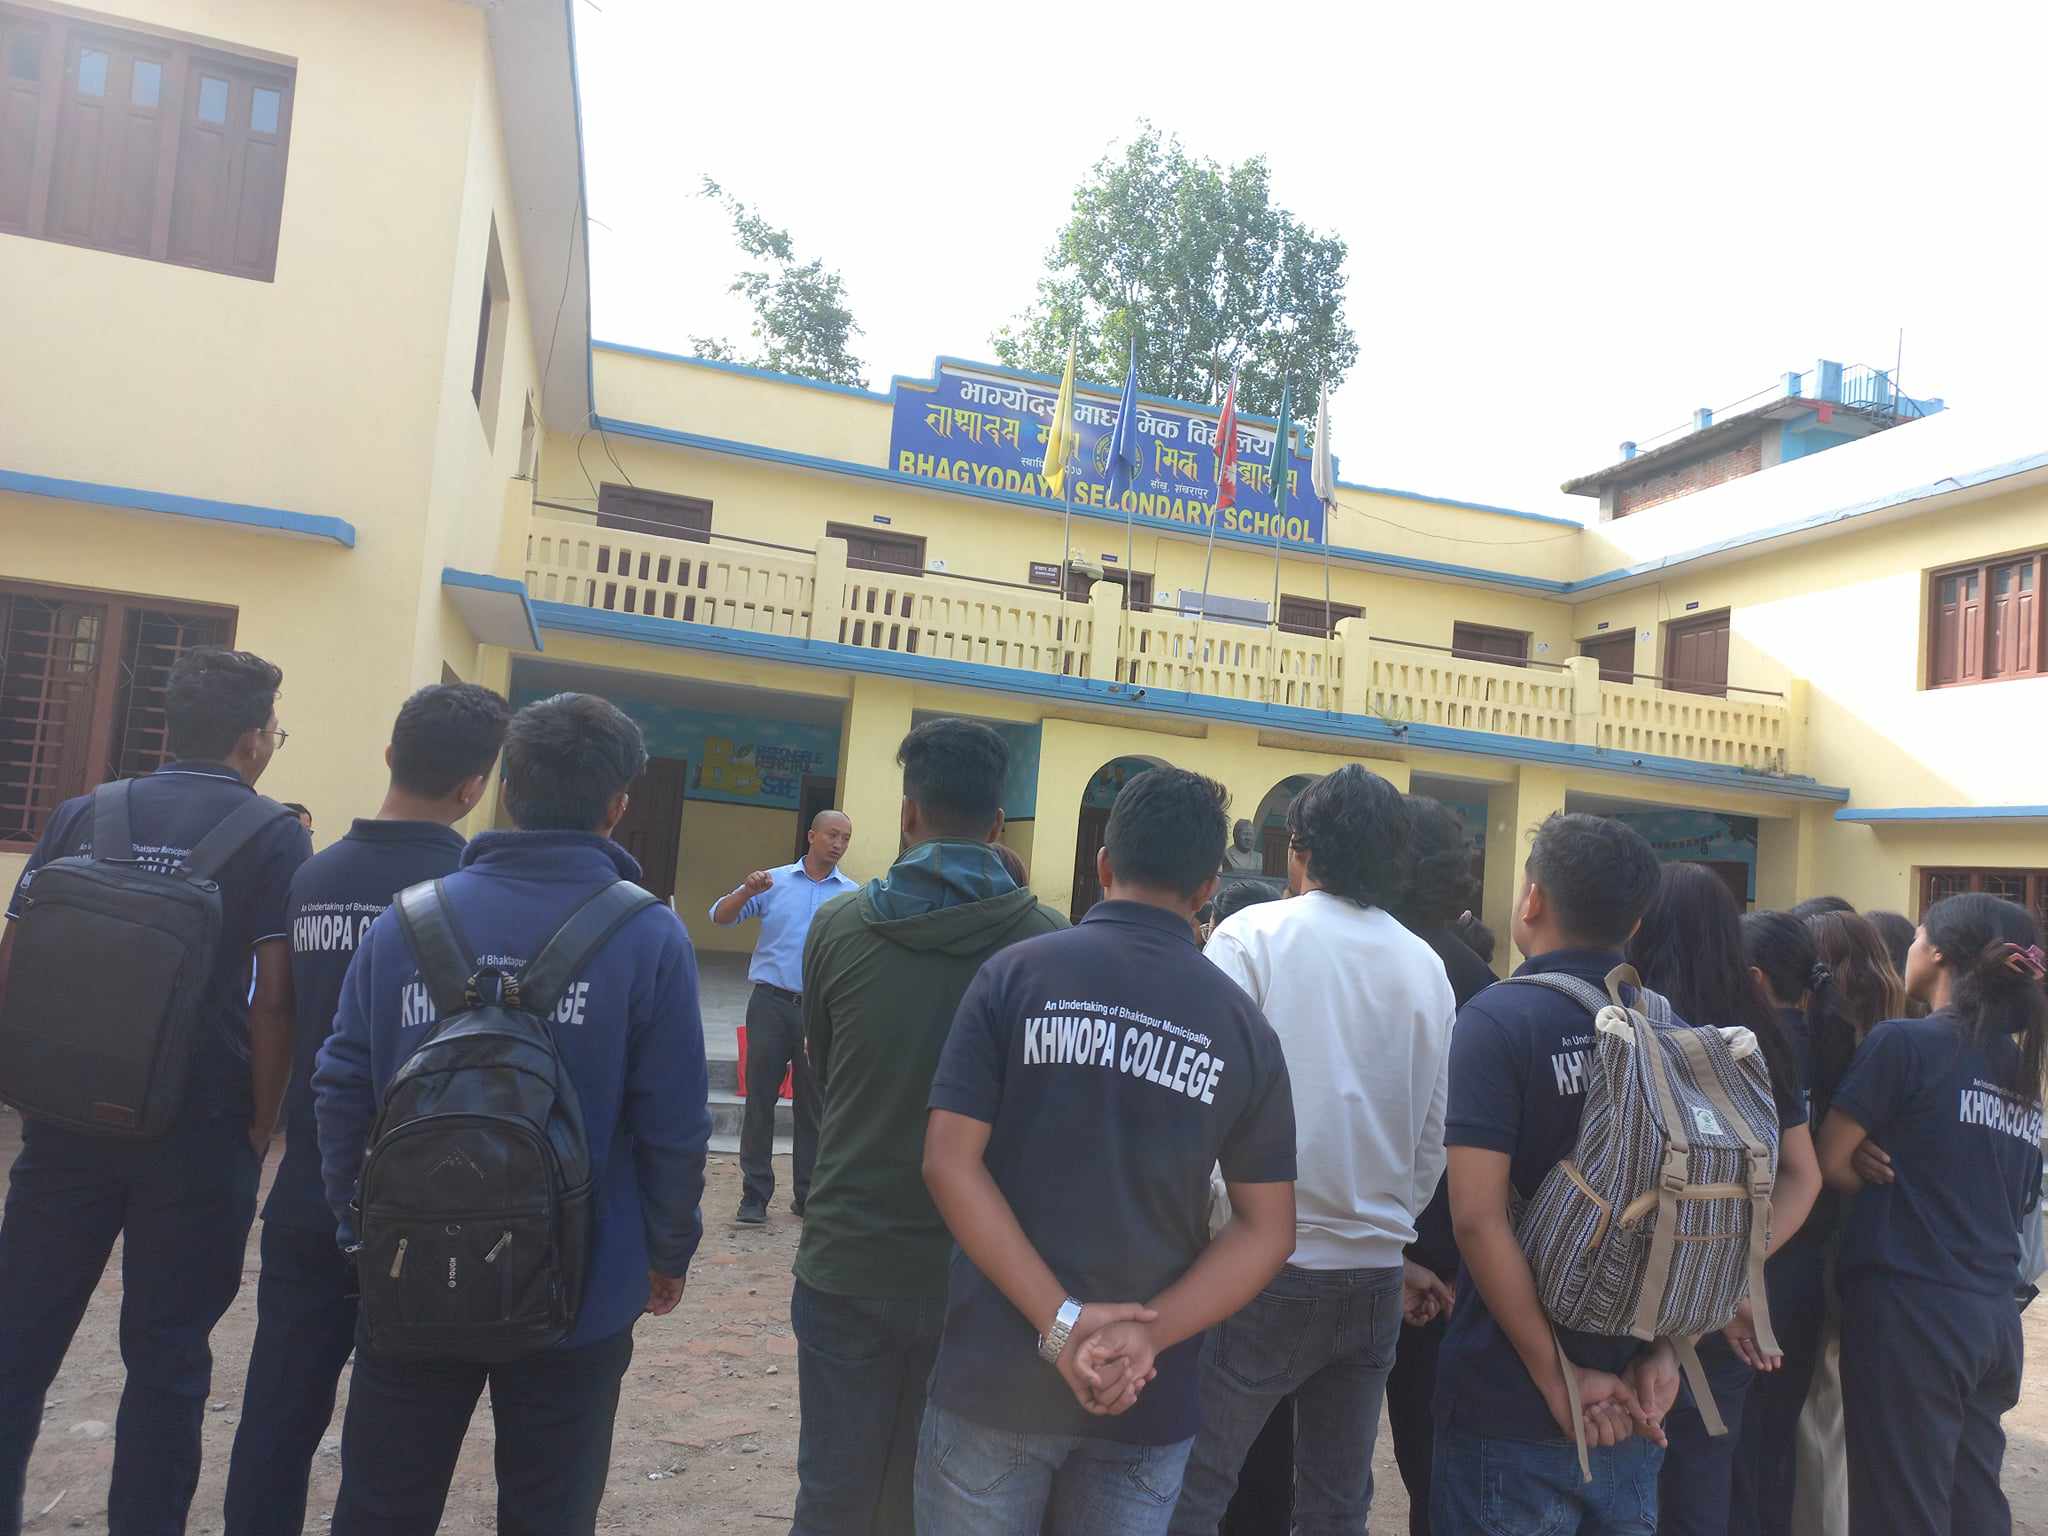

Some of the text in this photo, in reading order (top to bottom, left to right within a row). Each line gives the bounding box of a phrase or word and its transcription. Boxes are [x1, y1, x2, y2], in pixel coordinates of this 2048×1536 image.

[1224, 507, 1315, 543] SCHOOL
[307, 903, 343, 912] Undertaking
[293, 915, 352, 953] KHWOPA
[477, 955, 485, 965] of
[1044, 1000, 1212, 1049] An Undertaking of Bhaktapur Municipality
[1023, 1016, 1225, 1105] KHWOPA COLLEGE
